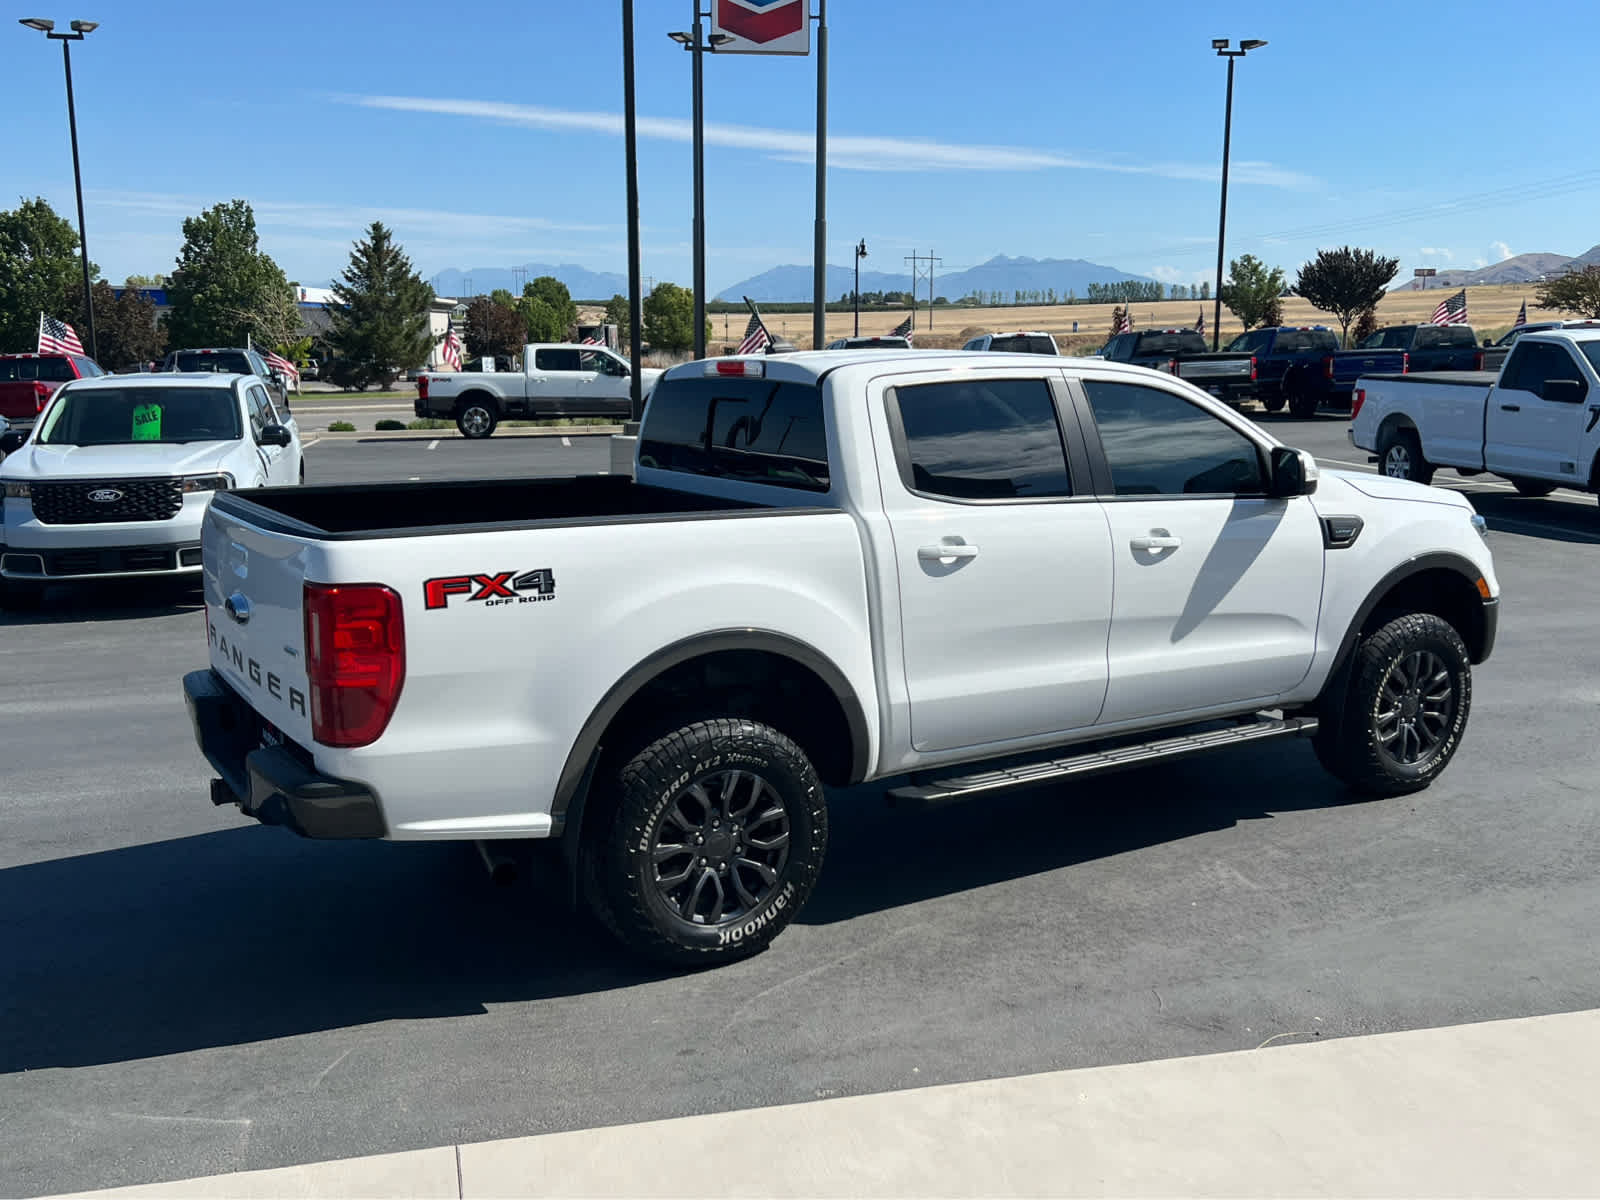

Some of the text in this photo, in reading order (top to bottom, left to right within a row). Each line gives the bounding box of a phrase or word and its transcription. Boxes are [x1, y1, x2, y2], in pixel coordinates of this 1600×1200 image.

[135, 410, 160, 425] SALE
[423, 568, 556, 610] FX4
[485, 593, 556, 607] OFF ROAD
[209, 623, 307, 719] RANGER
[693, 754, 721, 776] AT2
